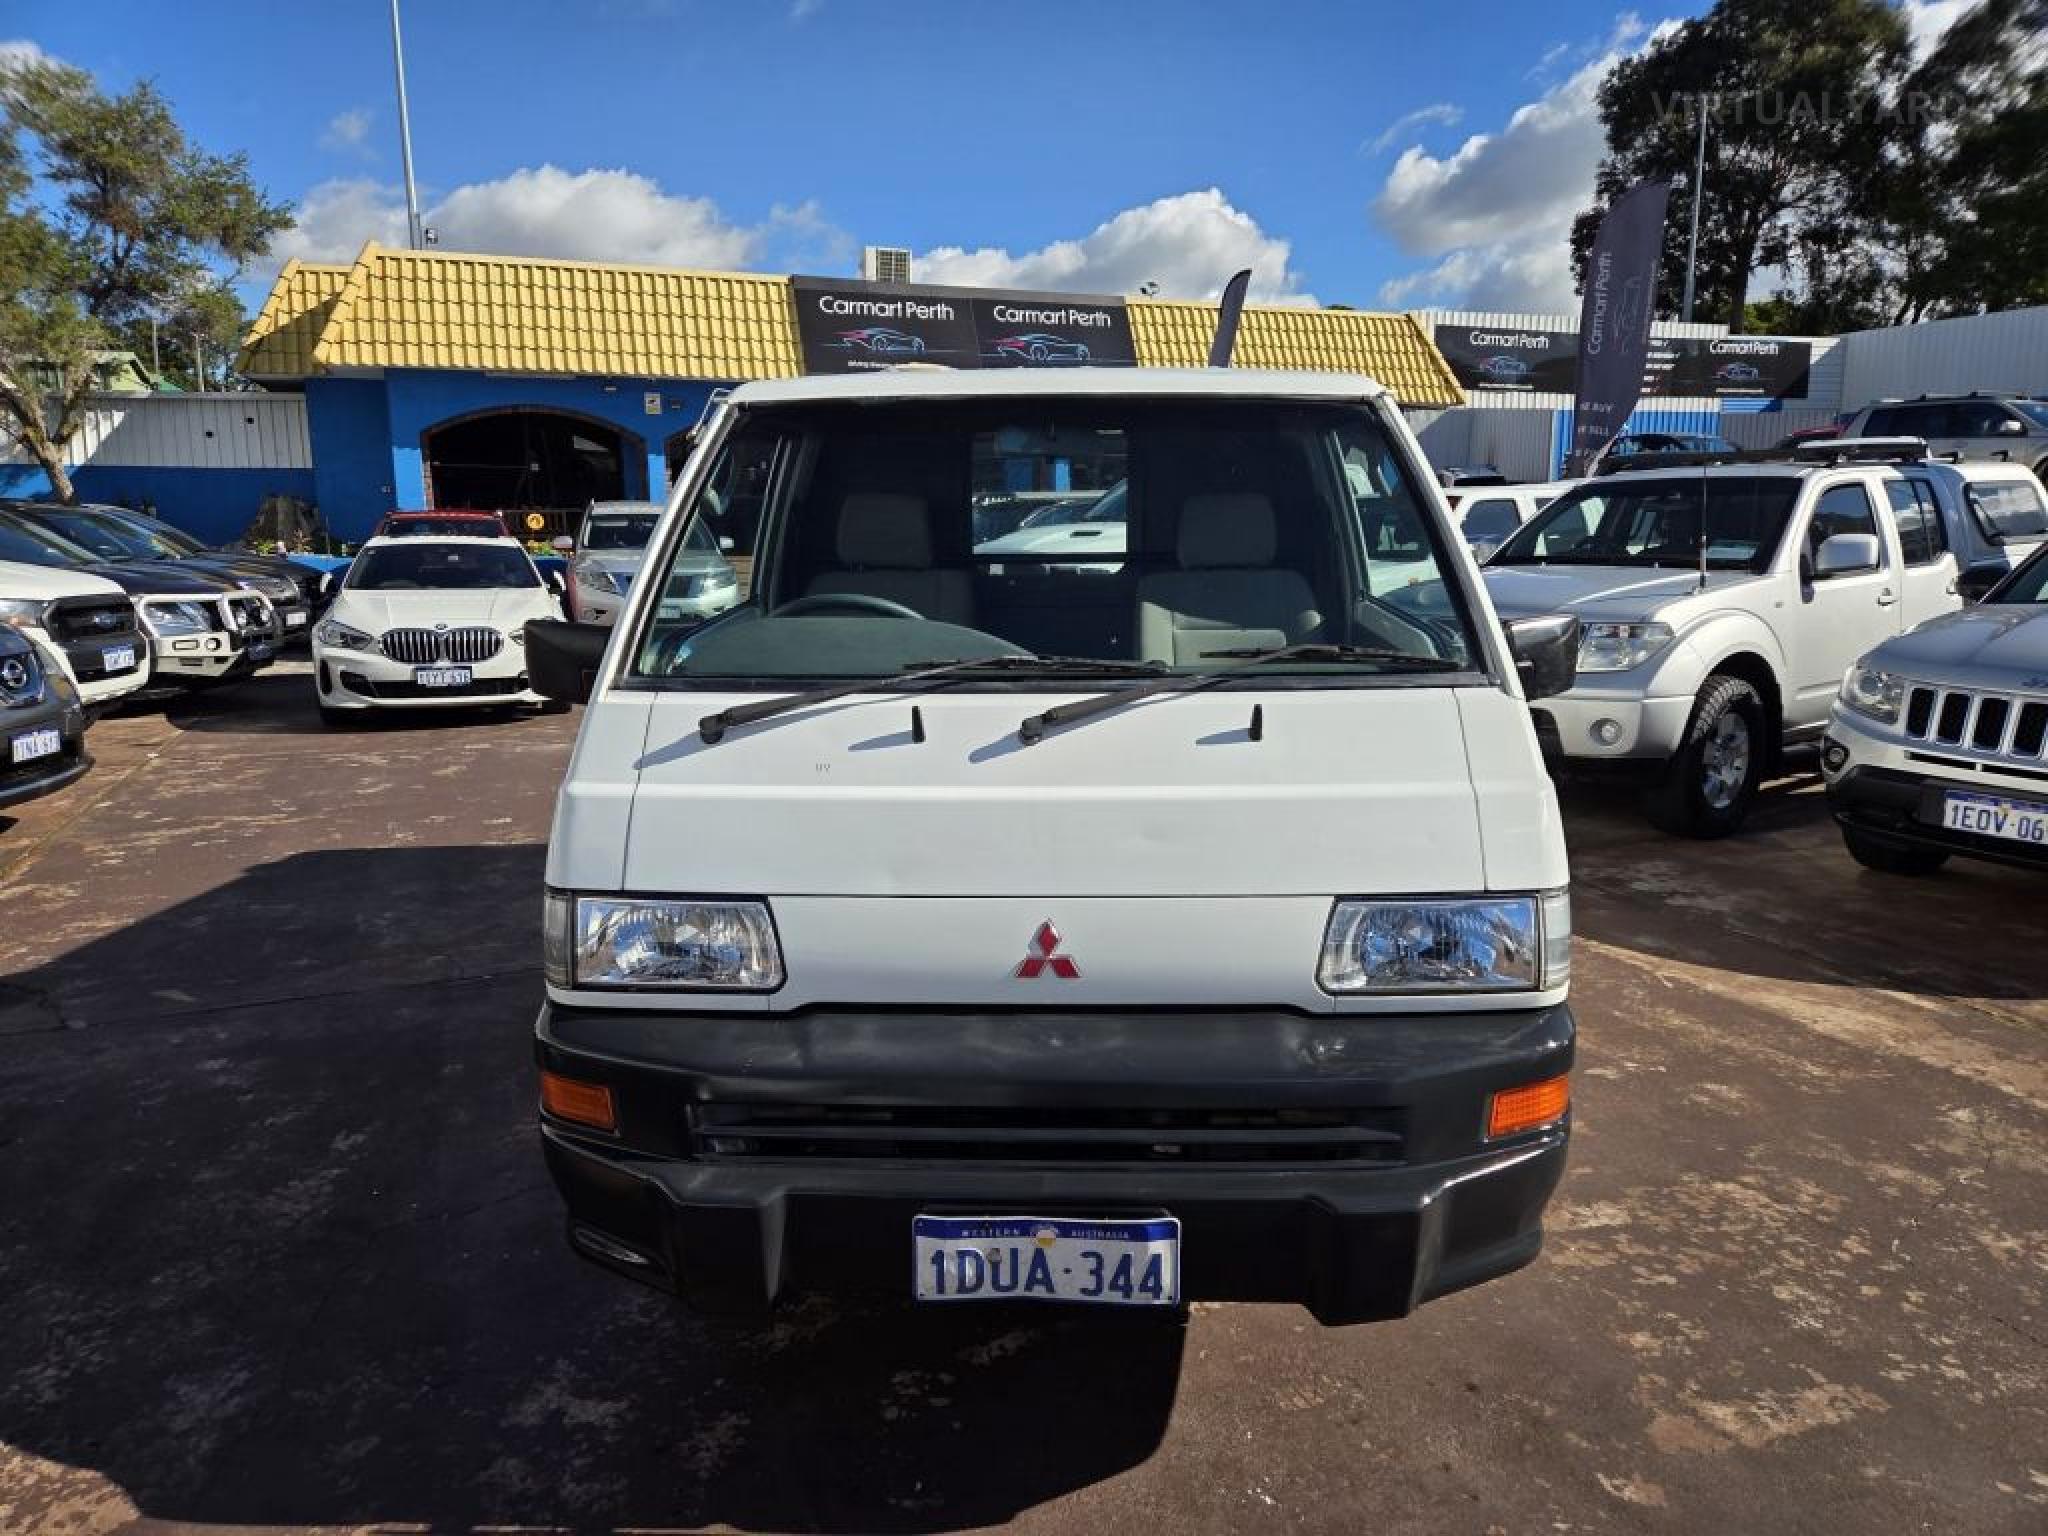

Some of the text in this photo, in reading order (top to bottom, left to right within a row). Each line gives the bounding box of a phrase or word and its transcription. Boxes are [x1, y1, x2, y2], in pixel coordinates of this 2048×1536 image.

[819, 295, 954, 321] Carmart Perth
[993, 305, 1111, 328] Carmart Perth
[1470, 331, 1549, 349] Carmart Perth
[1709, 340, 1752, 354] Carmart
[961, 1228, 1129, 1239] WESTERN AUSTRALIA
